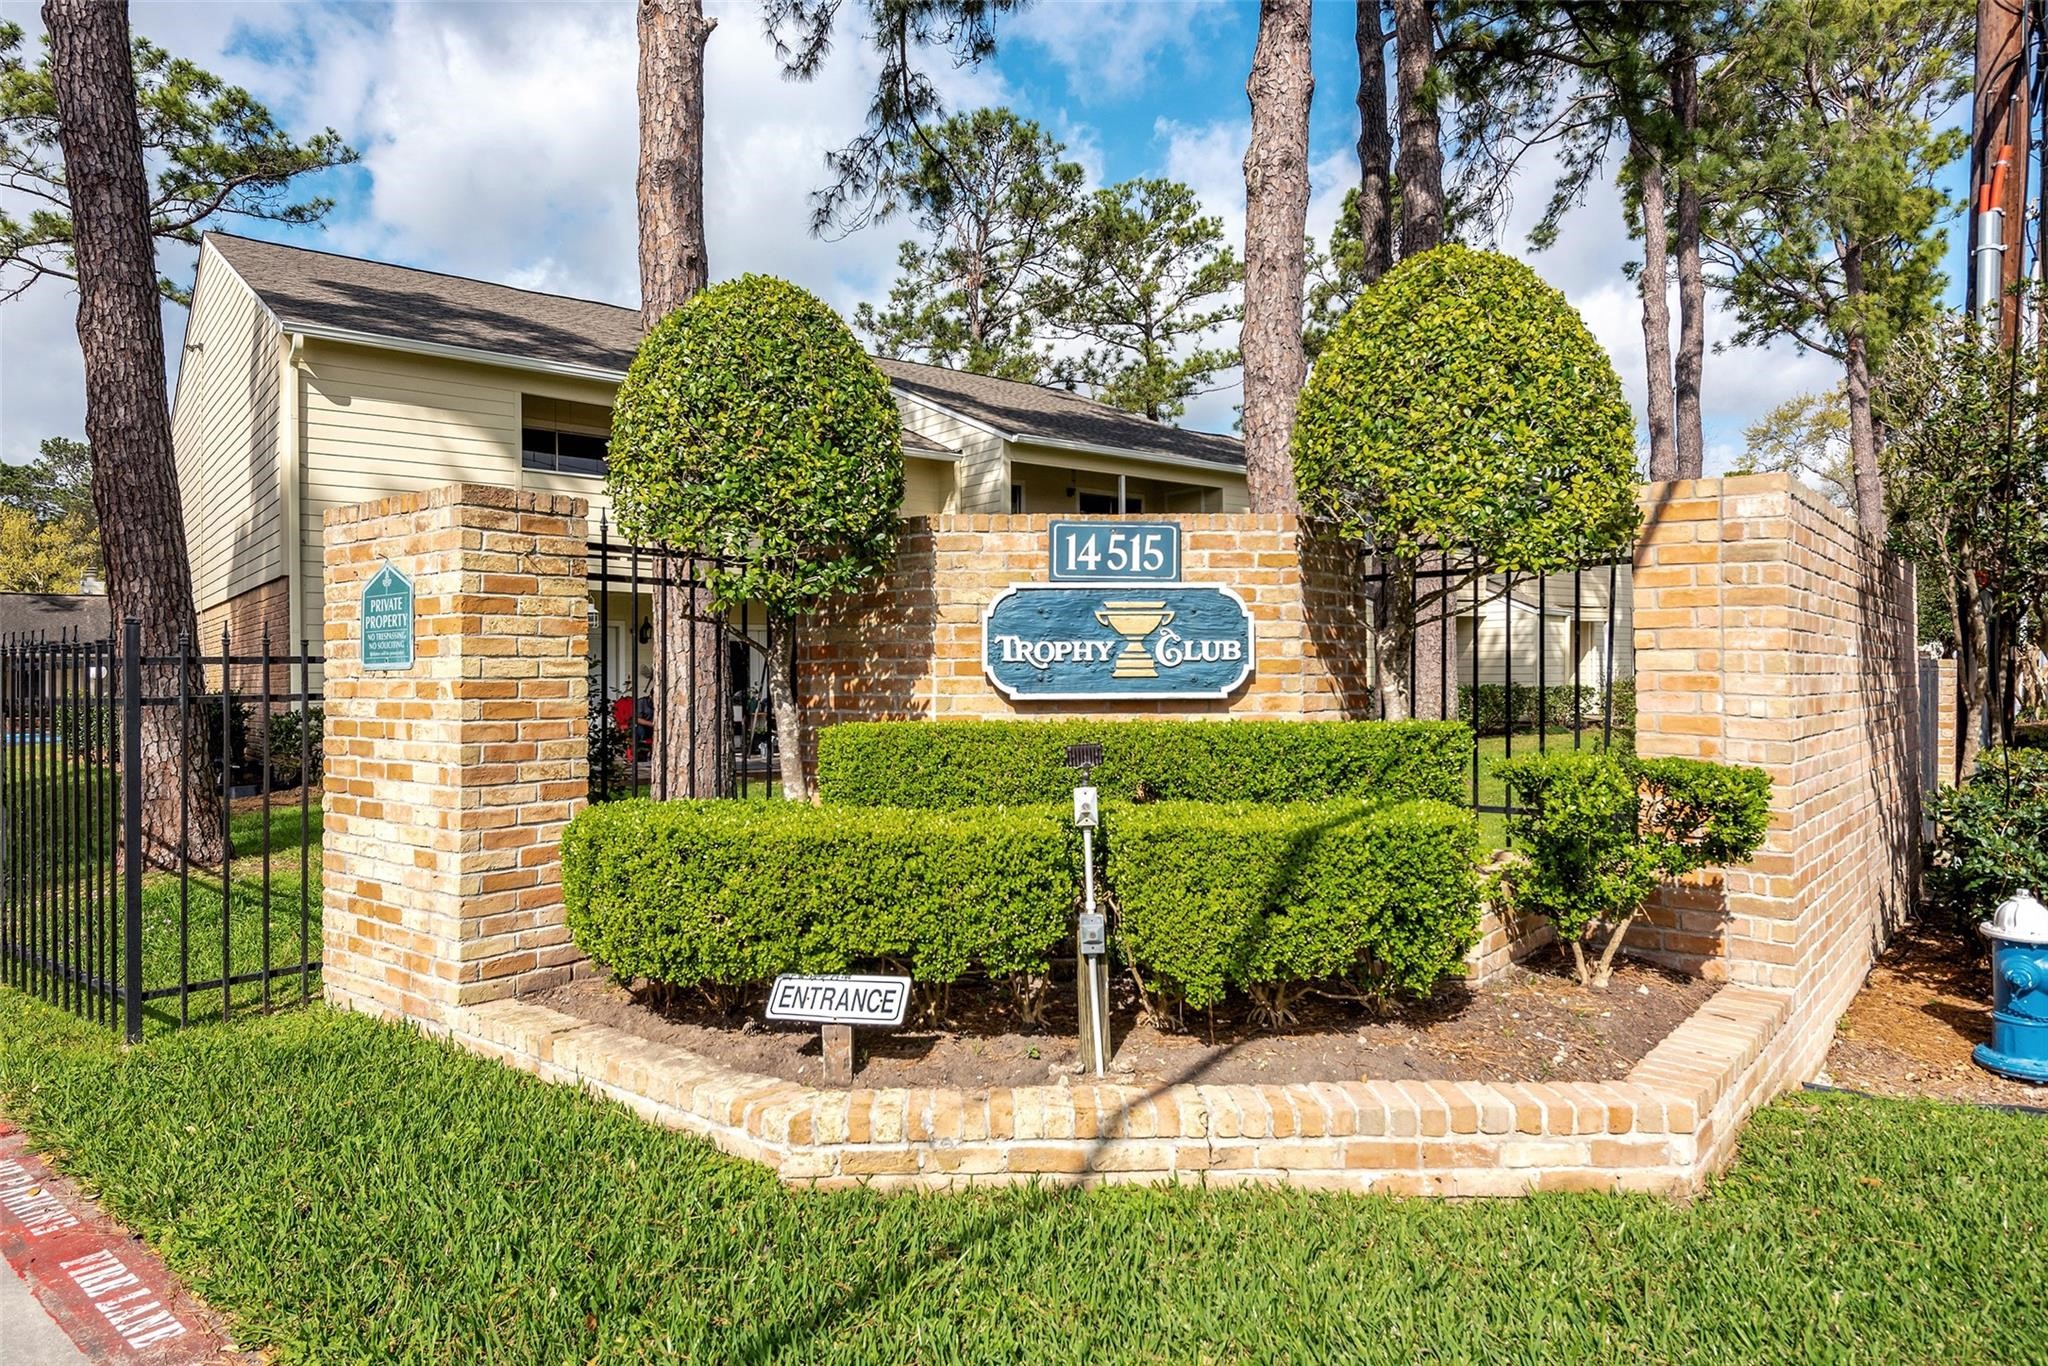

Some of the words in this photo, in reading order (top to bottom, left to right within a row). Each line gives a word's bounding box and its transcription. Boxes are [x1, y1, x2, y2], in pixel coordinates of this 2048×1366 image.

[370, 597, 403, 613] PRIVATE
[365, 613, 408, 629] PROPERTY
[367, 633, 375, 641] NO
[377, 641, 404, 649] SOLICITING
[993, 634, 1116, 670] TROPHY
[1154, 627, 1242, 668] CLUB
[778, 985, 897, 1014] ENTRANCE
[59, 1248, 139, 1299] FIRE
[95, 1287, 188, 1350] LANE
